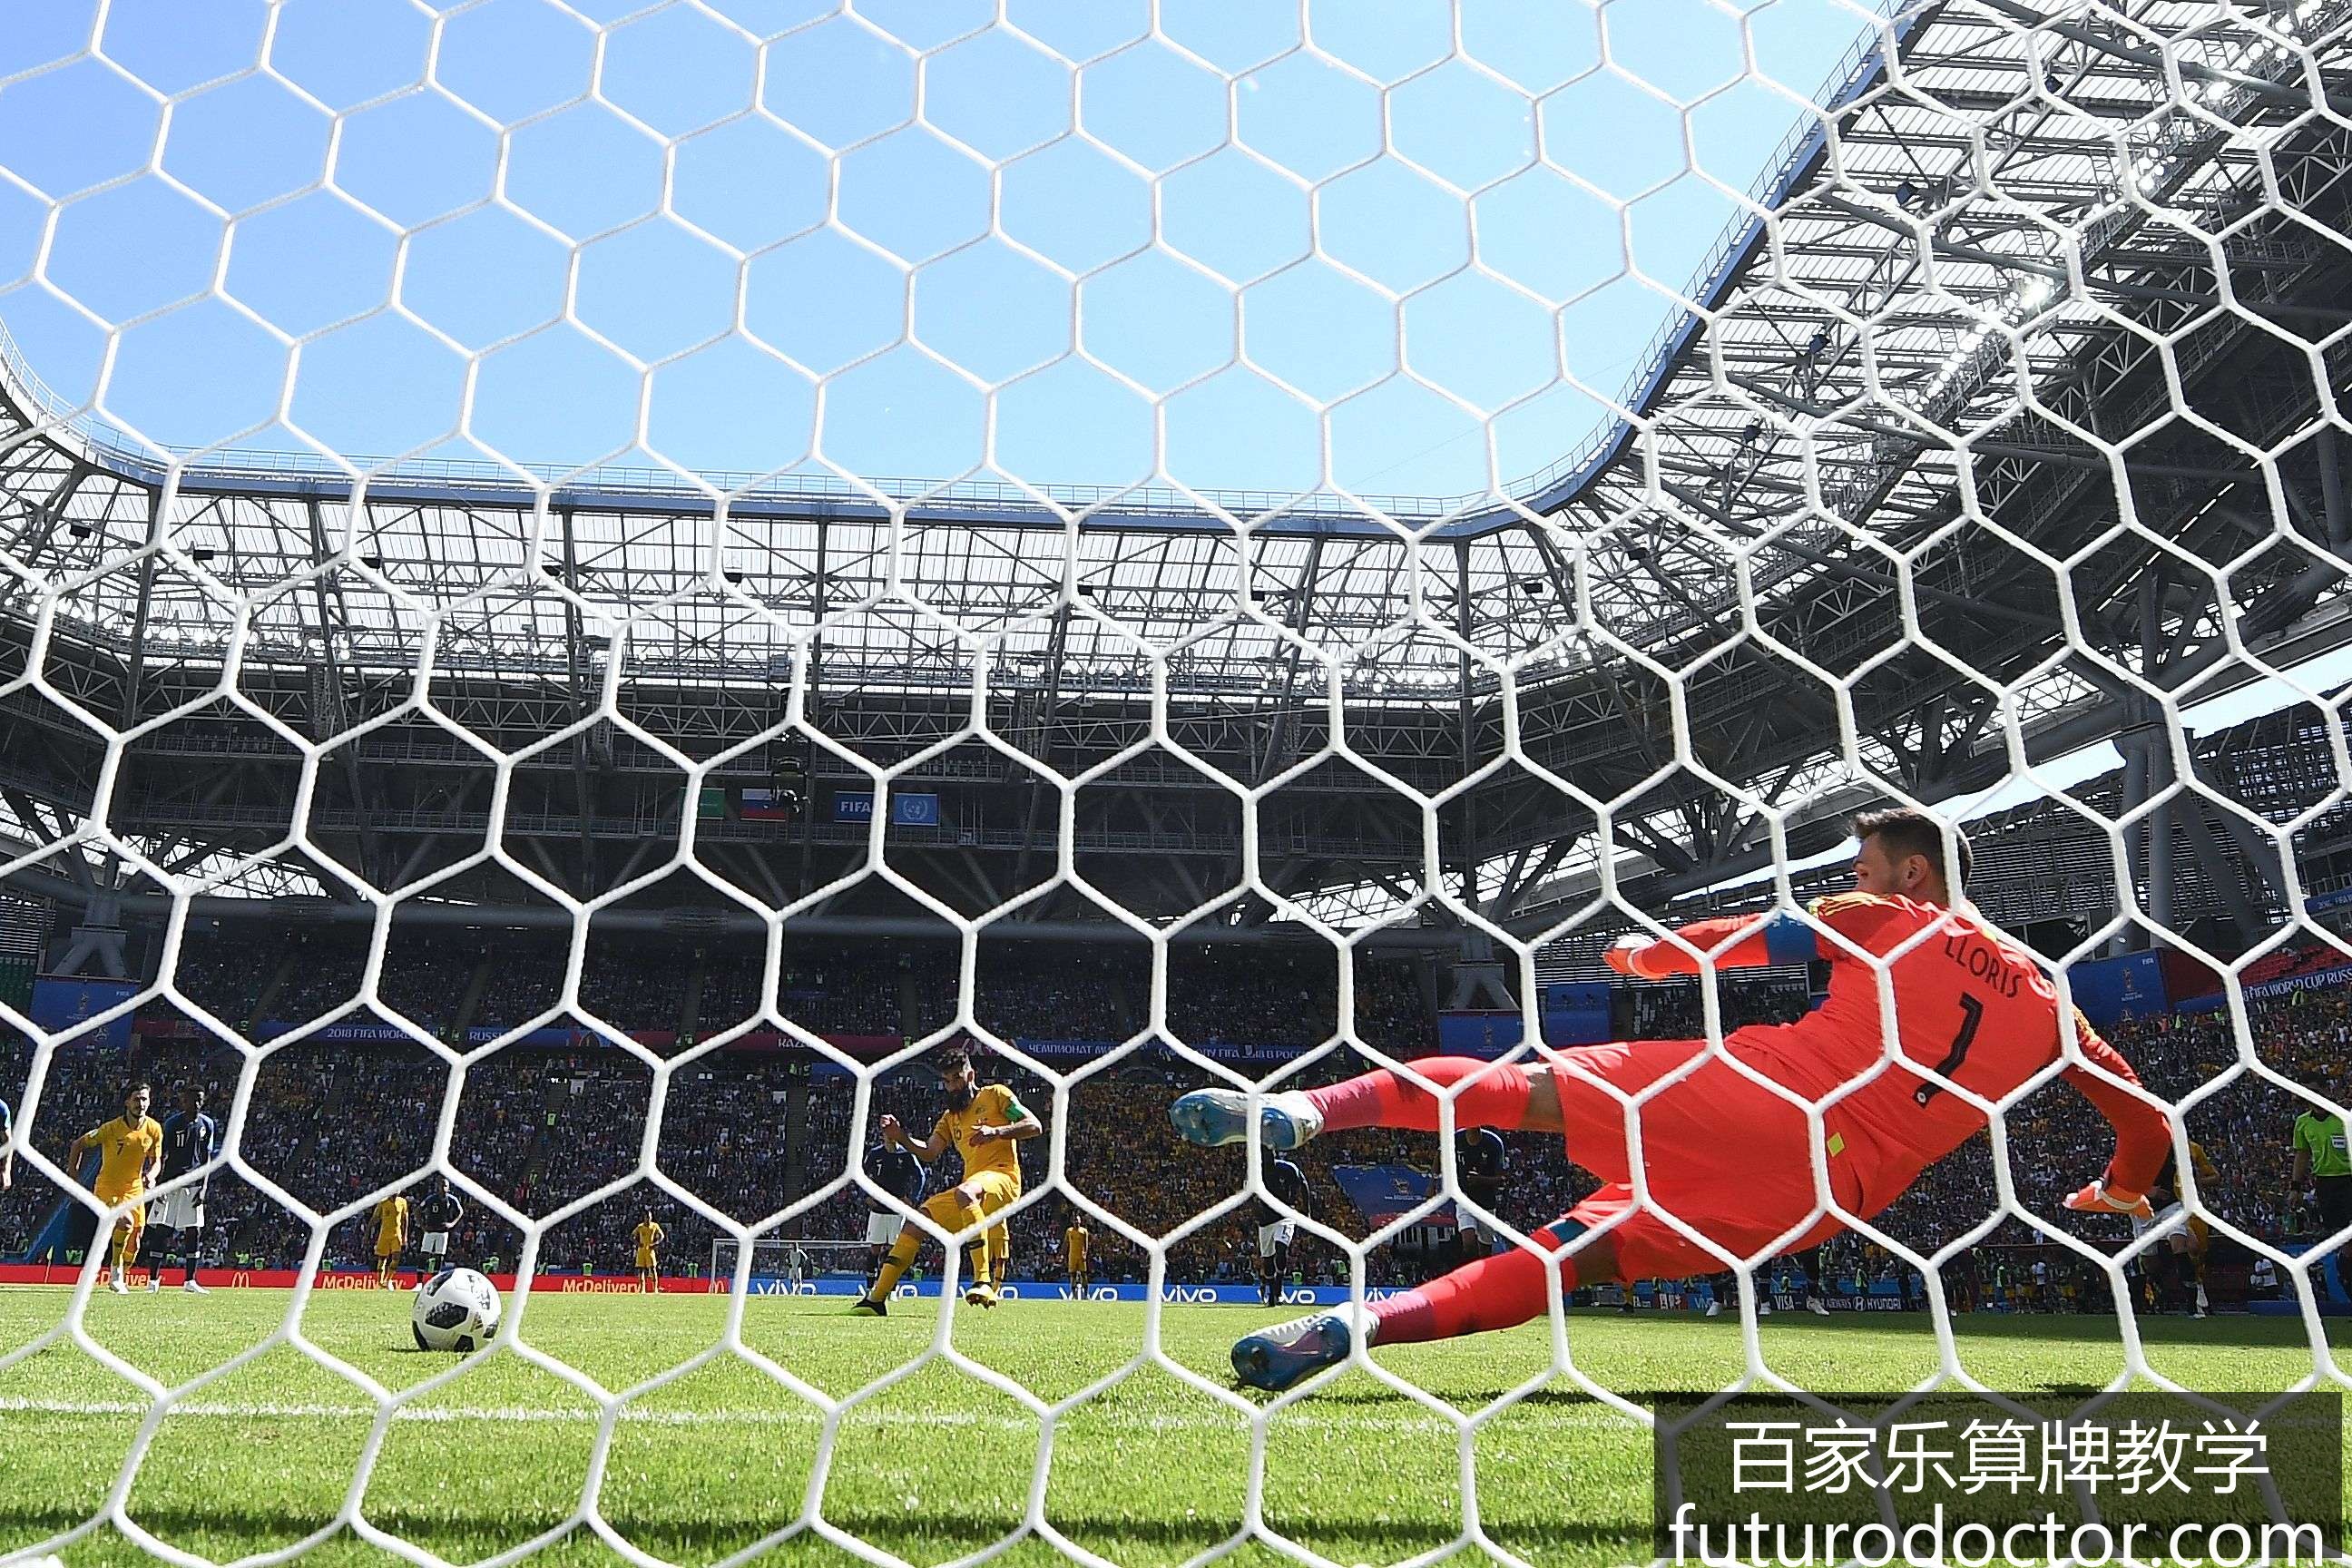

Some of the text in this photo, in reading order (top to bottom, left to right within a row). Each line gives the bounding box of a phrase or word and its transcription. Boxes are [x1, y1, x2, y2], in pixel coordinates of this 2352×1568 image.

[840, 801, 871, 813] FIFA
[1945, 936, 2023, 998] LLORIS
[2305, 974, 2326, 989] CUP
[327, 1028, 351, 1038] 2018
[353, 1028, 377, 1039] FIFA
[1028, 1044, 1091, 1054] ЧЕМПИОНАТ
[1913, 991, 1984, 1109] 7
[116, 1140, 125, 1156] 7
[176, 1133, 185, 1148] 11
[876, 1163, 883, 1177] 7
[563, 1279, 642, 1293] McDelivery
[1773, 1295, 1795, 1310] VISA
